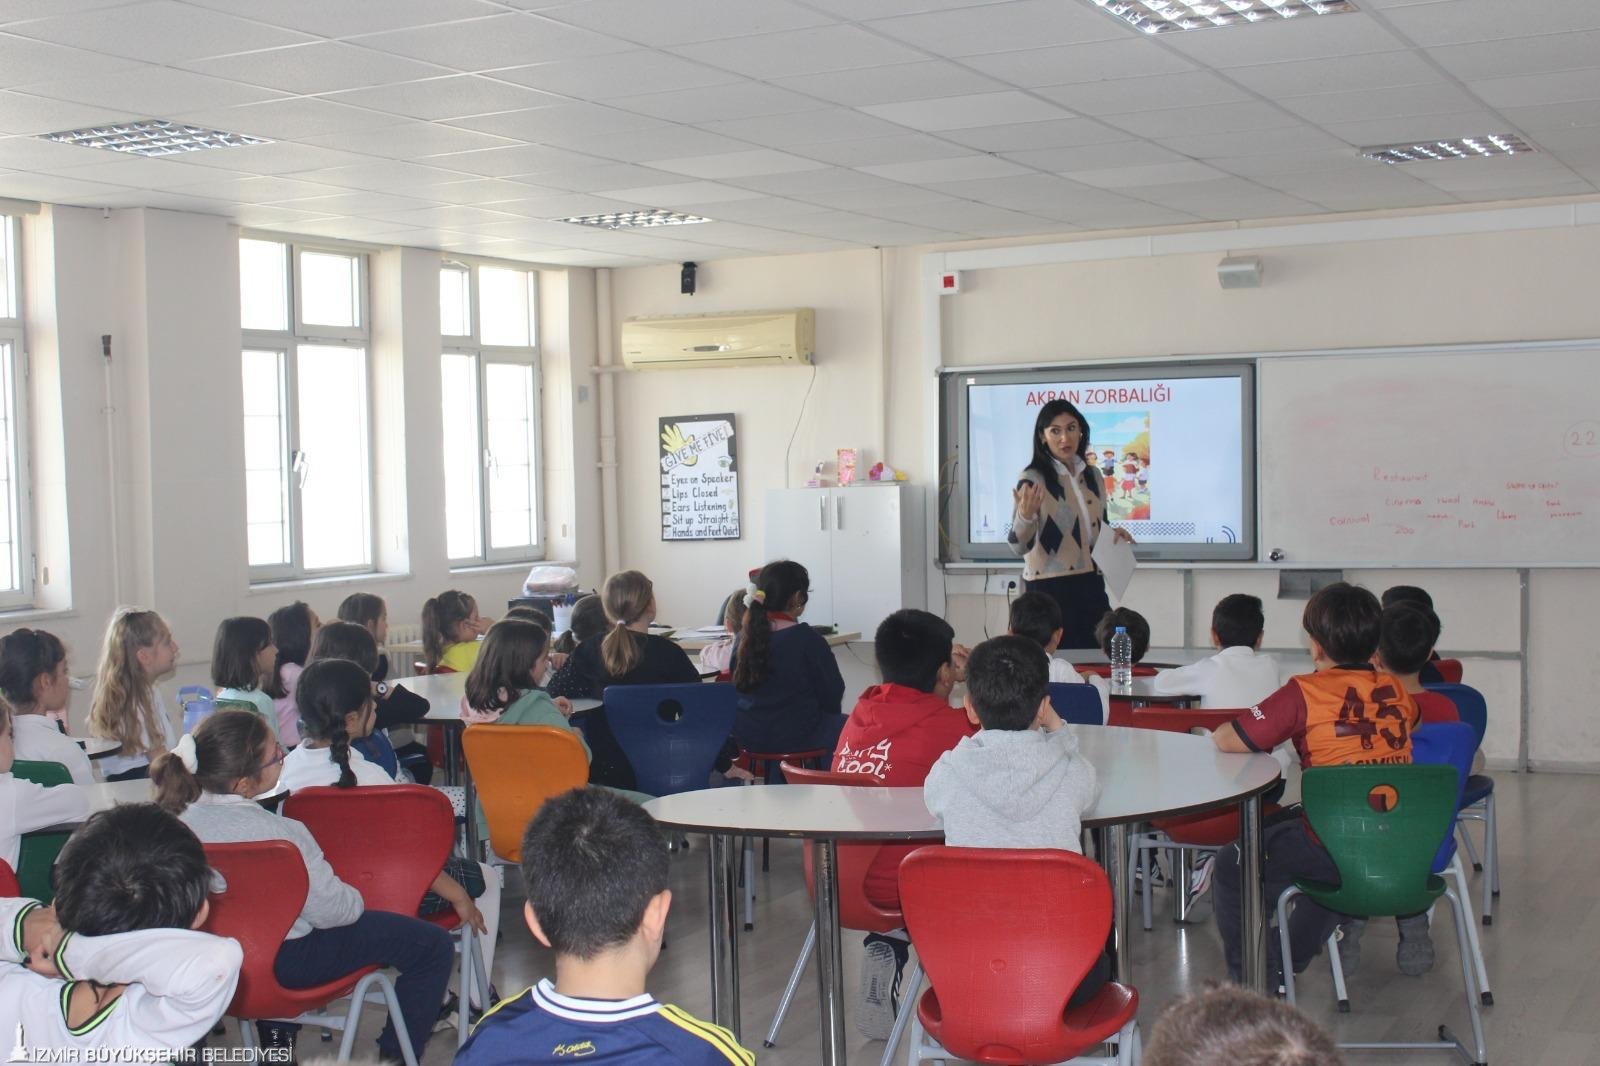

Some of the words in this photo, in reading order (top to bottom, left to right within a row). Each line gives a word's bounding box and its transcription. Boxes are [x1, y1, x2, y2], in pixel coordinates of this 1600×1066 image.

[1026, 390, 1079, 405] AKRAN
[1085, 384, 1171, 404] ZORBALIĞI
[665, 447, 689, 467] GIVE
[689, 440, 704, 456] ME
[690, 477, 699, 485] on
[701, 472, 734, 486] Speaker
[672, 488, 689, 500] Lips
[692, 486, 718, 498] Closed
[672, 501, 690, 512] Ears
[693, 500, 727, 513] Listening
[672, 514, 683, 525] Sit
[685, 518, 694, 527] up
[697, 512, 729, 525] Straight
[672, 526, 693, 537] Hands
[694, 526, 707, 537] and
[708, 525, 721, 536] Feet
[1335, 685, 1408, 750] 45
